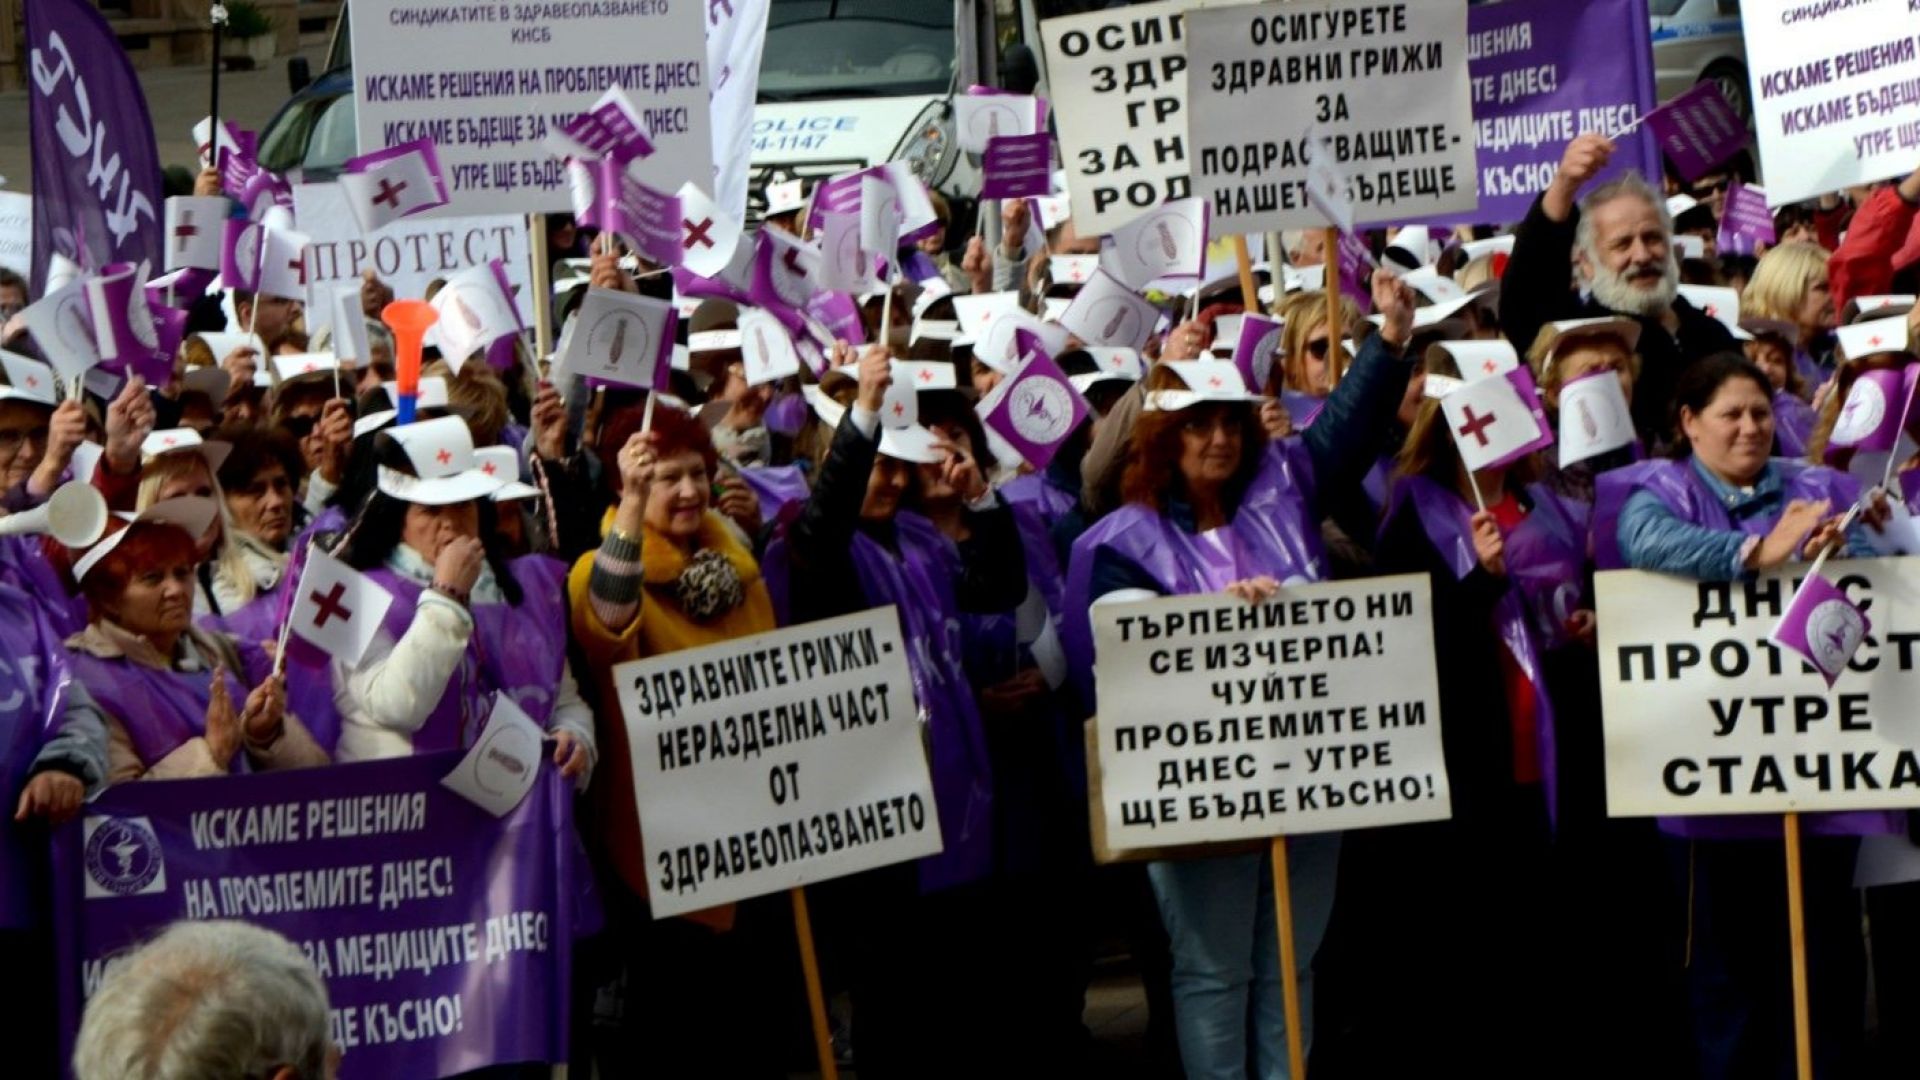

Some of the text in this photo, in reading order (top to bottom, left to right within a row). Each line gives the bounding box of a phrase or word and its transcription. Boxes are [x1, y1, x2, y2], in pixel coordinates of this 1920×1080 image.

[389, 0, 668, 27] СИНДИКАТИТЕ В ЗДРАВЕОПАЗВАНЕТО
[512, 27, 552, 43] КНСБ
[1251, 5, 1406, 45] ОСИГУРЕТЕ
[366, 61, 701, 102] ИСКАМЕ РЕШЕНИЯ НА ПРОБЛЕМИТЕ ДНЕС!
[1091, 55, 1187, 94] ЗДР
[1212, 42, 1443, 94] ЗДРАВНИ ГРИЖИ
[1500, 64, 1557, 104] ДНЕС!
[1761, 36, 1915, 99] ИСКАМЕ РЕШЕНИЯ
[384, 116, 452, 148] ИСКАМЕ
[458, 113, 524, 147] БЪДЕЩЕ
[526, 114, 548, 141] ЗА
[1126, 97, 1180, 128] ГР
[1316, 94, 1349, 123] ЗА
[1579, 103, 1637, 137] ДНЕС!
[1782, 95, 1853, 137] ИСКАМЕ
[1079, 143, 1140, 175] ЗА
[1154, 136, 1184, 164] Н
[1854, 127, 1894, 160] УТРЕ
[452, 158, 563, 191] УТРЕ ЩЕ БЪДЕ
[314, 225, 515, 281] ПРОТЕСТ
[1116, 591, 1413, 642] ТЪРПЕНИЕТО НИ
[1693, 574, 1873, 628] ДНС
[634, 647, 788, 719] ЗДРАВНИТЕ
[789, 628, 879, 683] ГРИЖИ
[1149, 631, 1385, 675] СЕ ИЗЧЕРПА!
[1618, 632, 1920, 682] ПРОТСТ
[1212, 672, 1329, 705] ЧУЙТЕ
[657, 684, 890, 771] НЕРАЗДЕЛНА ЧАСТ
[1115, 701, 1426, 752] ПРОБЛЕМИТЕ НИ
[1708, 694, 1872, 736] УТРЕ
[770, 762, 800, 806] ОТ
[1157, 753, 1258, 790] ДНЕС
[1305, 741, 1392, 772] УТРЕ
[1662, 751, 1920, 796] СТАЧКА
[190, 791, 427, 850] ИСКАМЕ РЕШЕНИЯ
[1121, 774, 1435, 829] ЩЕ БЪДЕ КЪСНО!
[657, 792, 925, 895] ЗДРАВЕОПАЗВАНЕТО
[184, 856, 454, 919] НА ПРОБЛЕМИТЕ ДНЕС!
[335, 923, 479, 981] МЕДИЦИТЕ
[364, 994, 463, 1045] КЪСНО!
